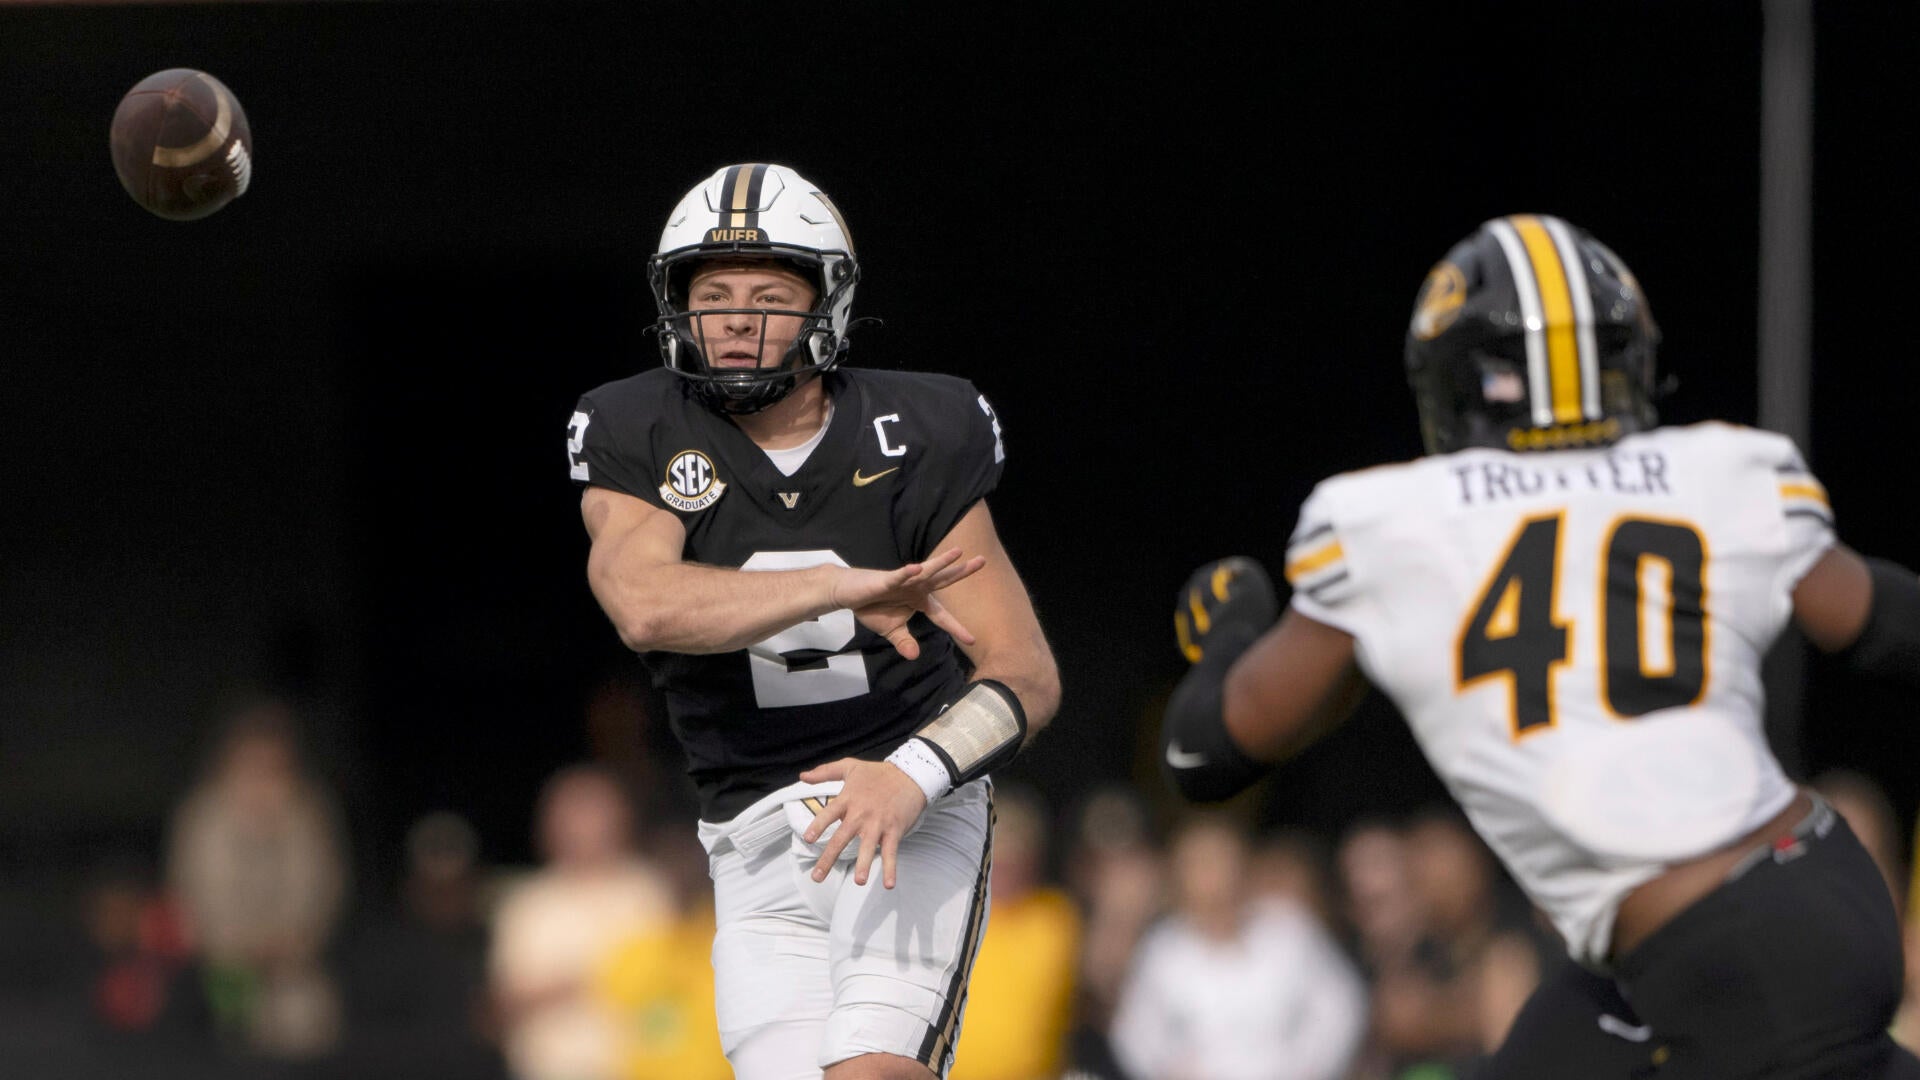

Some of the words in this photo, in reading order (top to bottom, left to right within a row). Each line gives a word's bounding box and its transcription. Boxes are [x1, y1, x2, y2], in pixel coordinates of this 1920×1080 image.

[566, 410, 590, 482] 2
[873, 412, 908, 458] C
[670, 453, 711, 496] SEC
[665, 491, 718, 510] GRADUATE
[1452, 506, 1711, 744] 40
